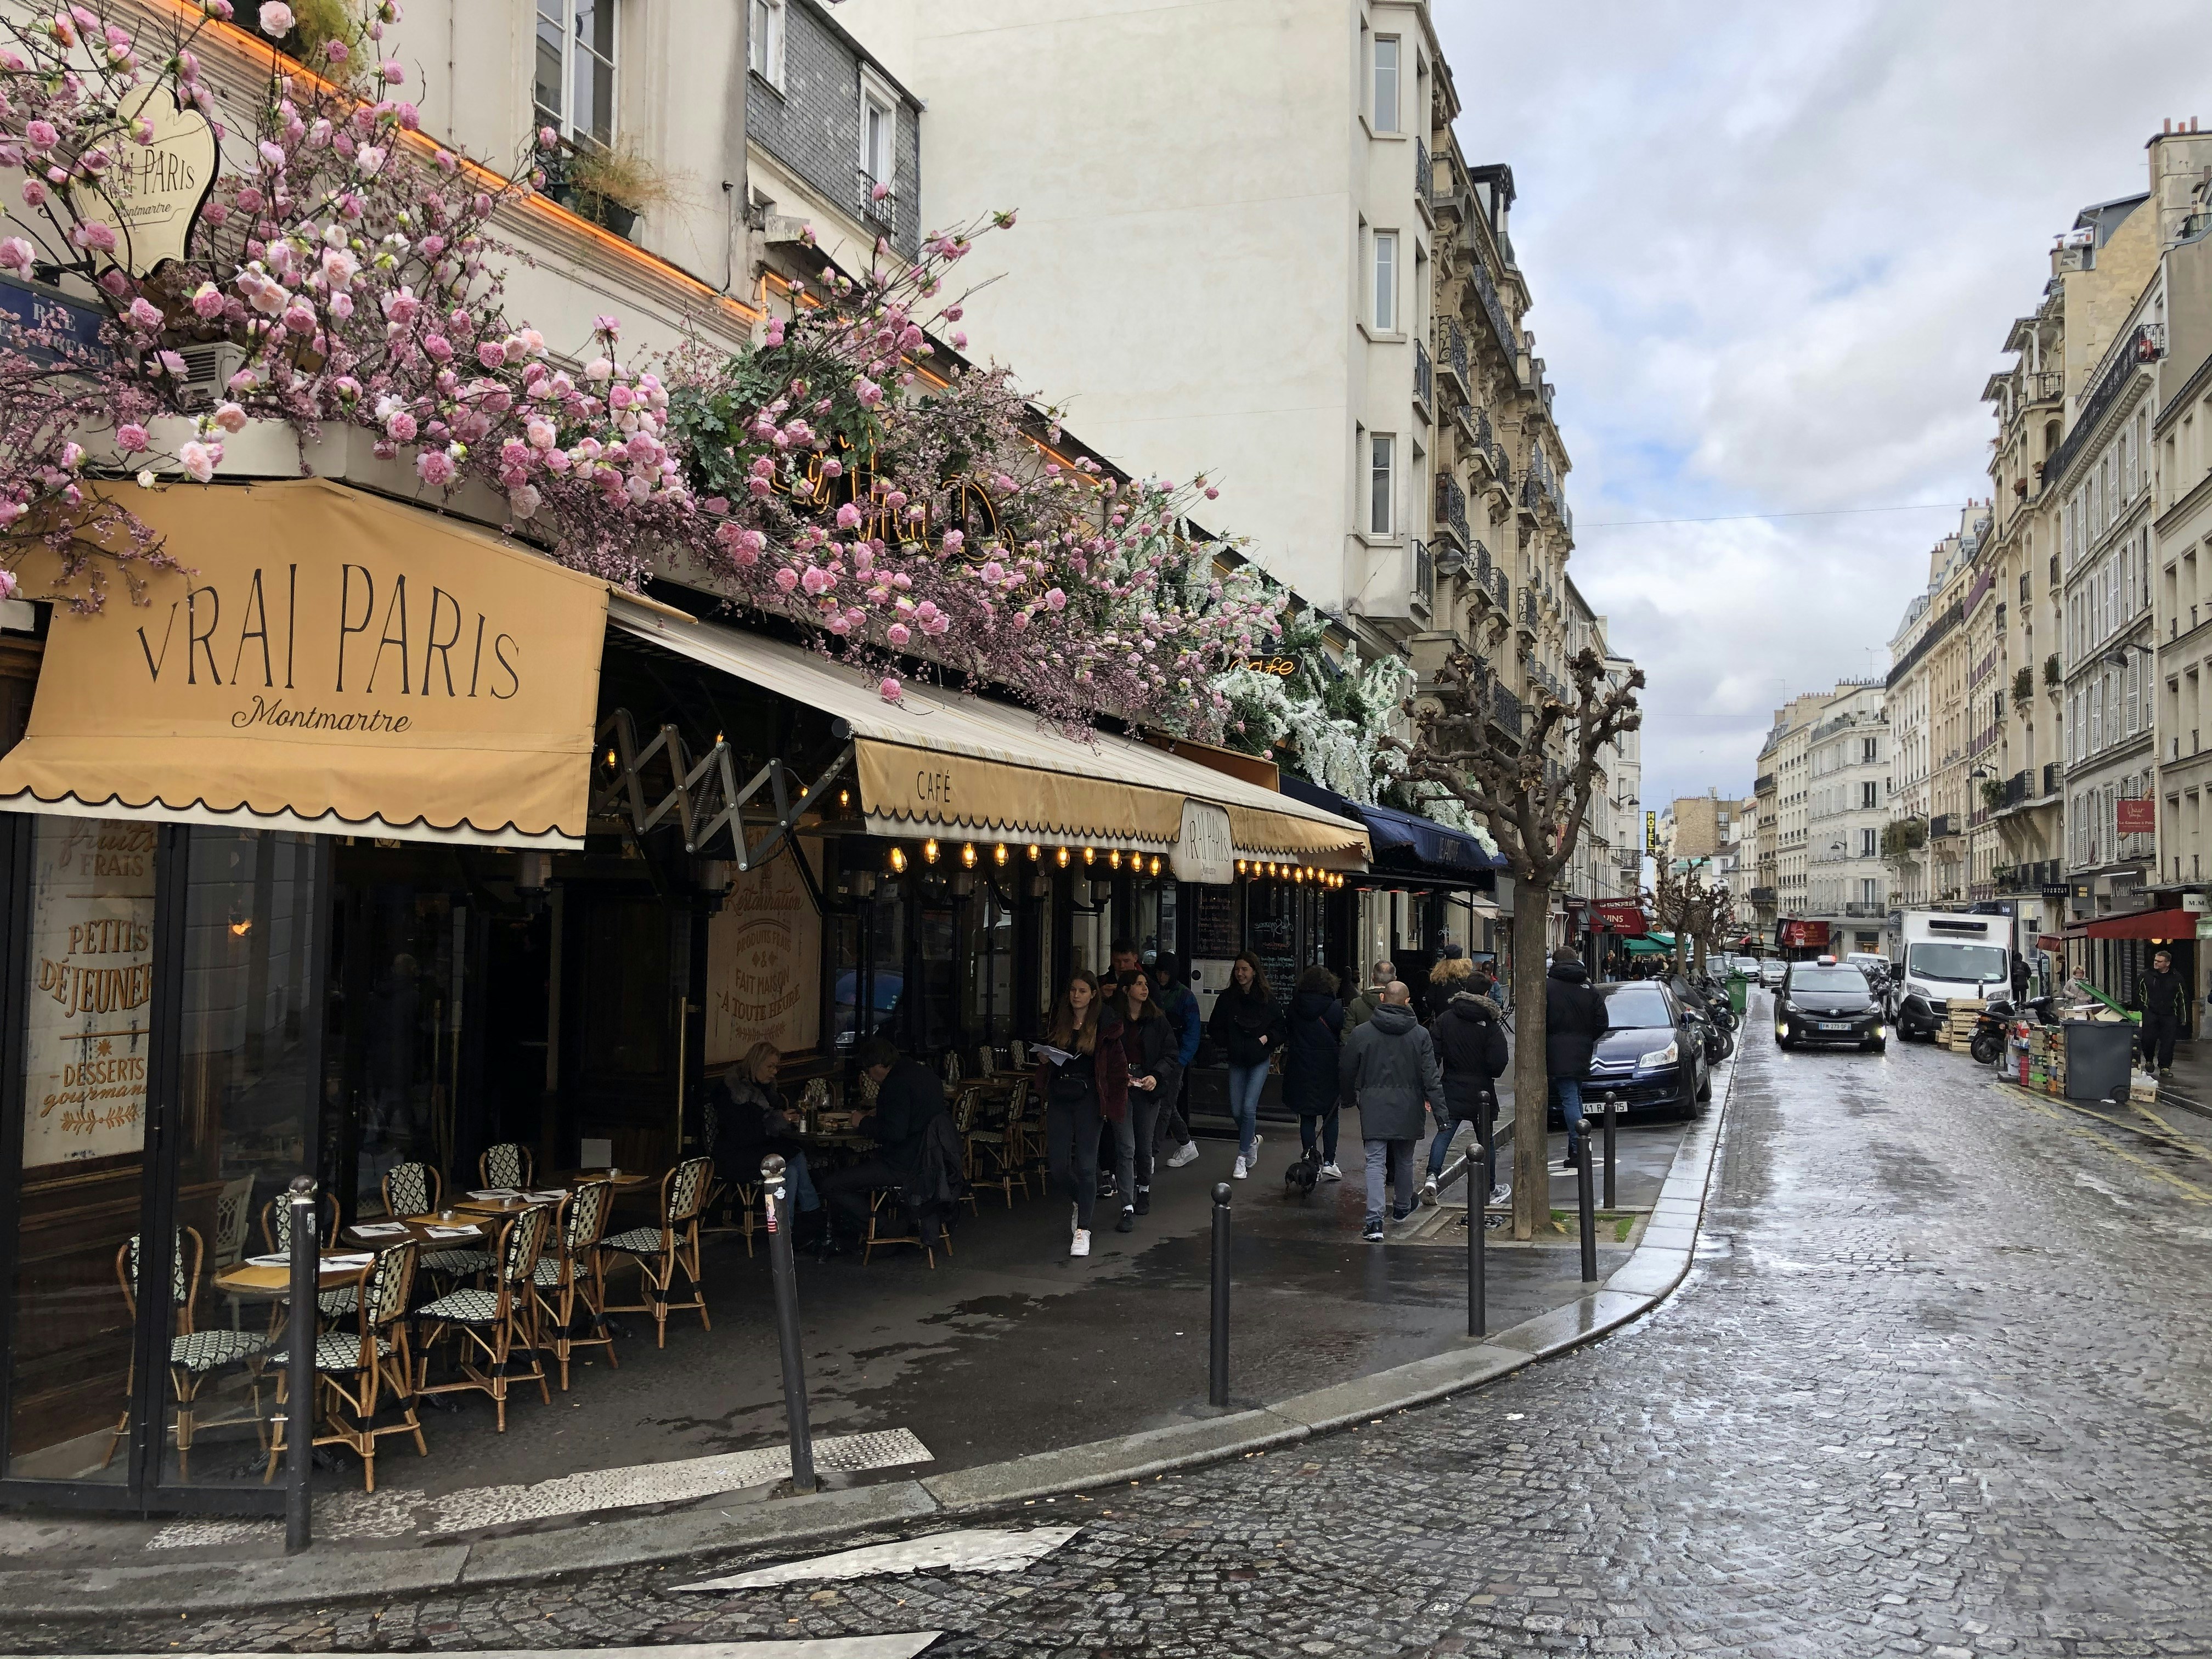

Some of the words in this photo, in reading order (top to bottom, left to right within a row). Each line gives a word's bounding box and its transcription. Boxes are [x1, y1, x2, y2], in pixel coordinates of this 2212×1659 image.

[144, 149, 195, 195] PARIS
[33, 302, 76, 332] RE
[136, 563, 296, 690] VRAI
[335, 563, 520, 700] PARIS
[231, 695, 413, 733] Montmartre
[916, 769, 951, 803] CAFÉ
[1206, 812, 1229, 862] PARIS
[80, 853, 144, 877] FRAIS
[67, 918, 149, 955] PETITS
[736, 930, 771, 957] PRODUITS
[772, 930, 792, 953] FRAIS
[760, 950, 768, 968] &
[736, 967, 756, 995] FAIT
[757, 964, 789, 995] MAISON
[732, 997, 766, 1022] TOUTE
[768, 983, 800, 1019] HEURE
[63, 1056, 145, 1087] DESSERTS
[1615, 1103, 1624, 1111] 75
